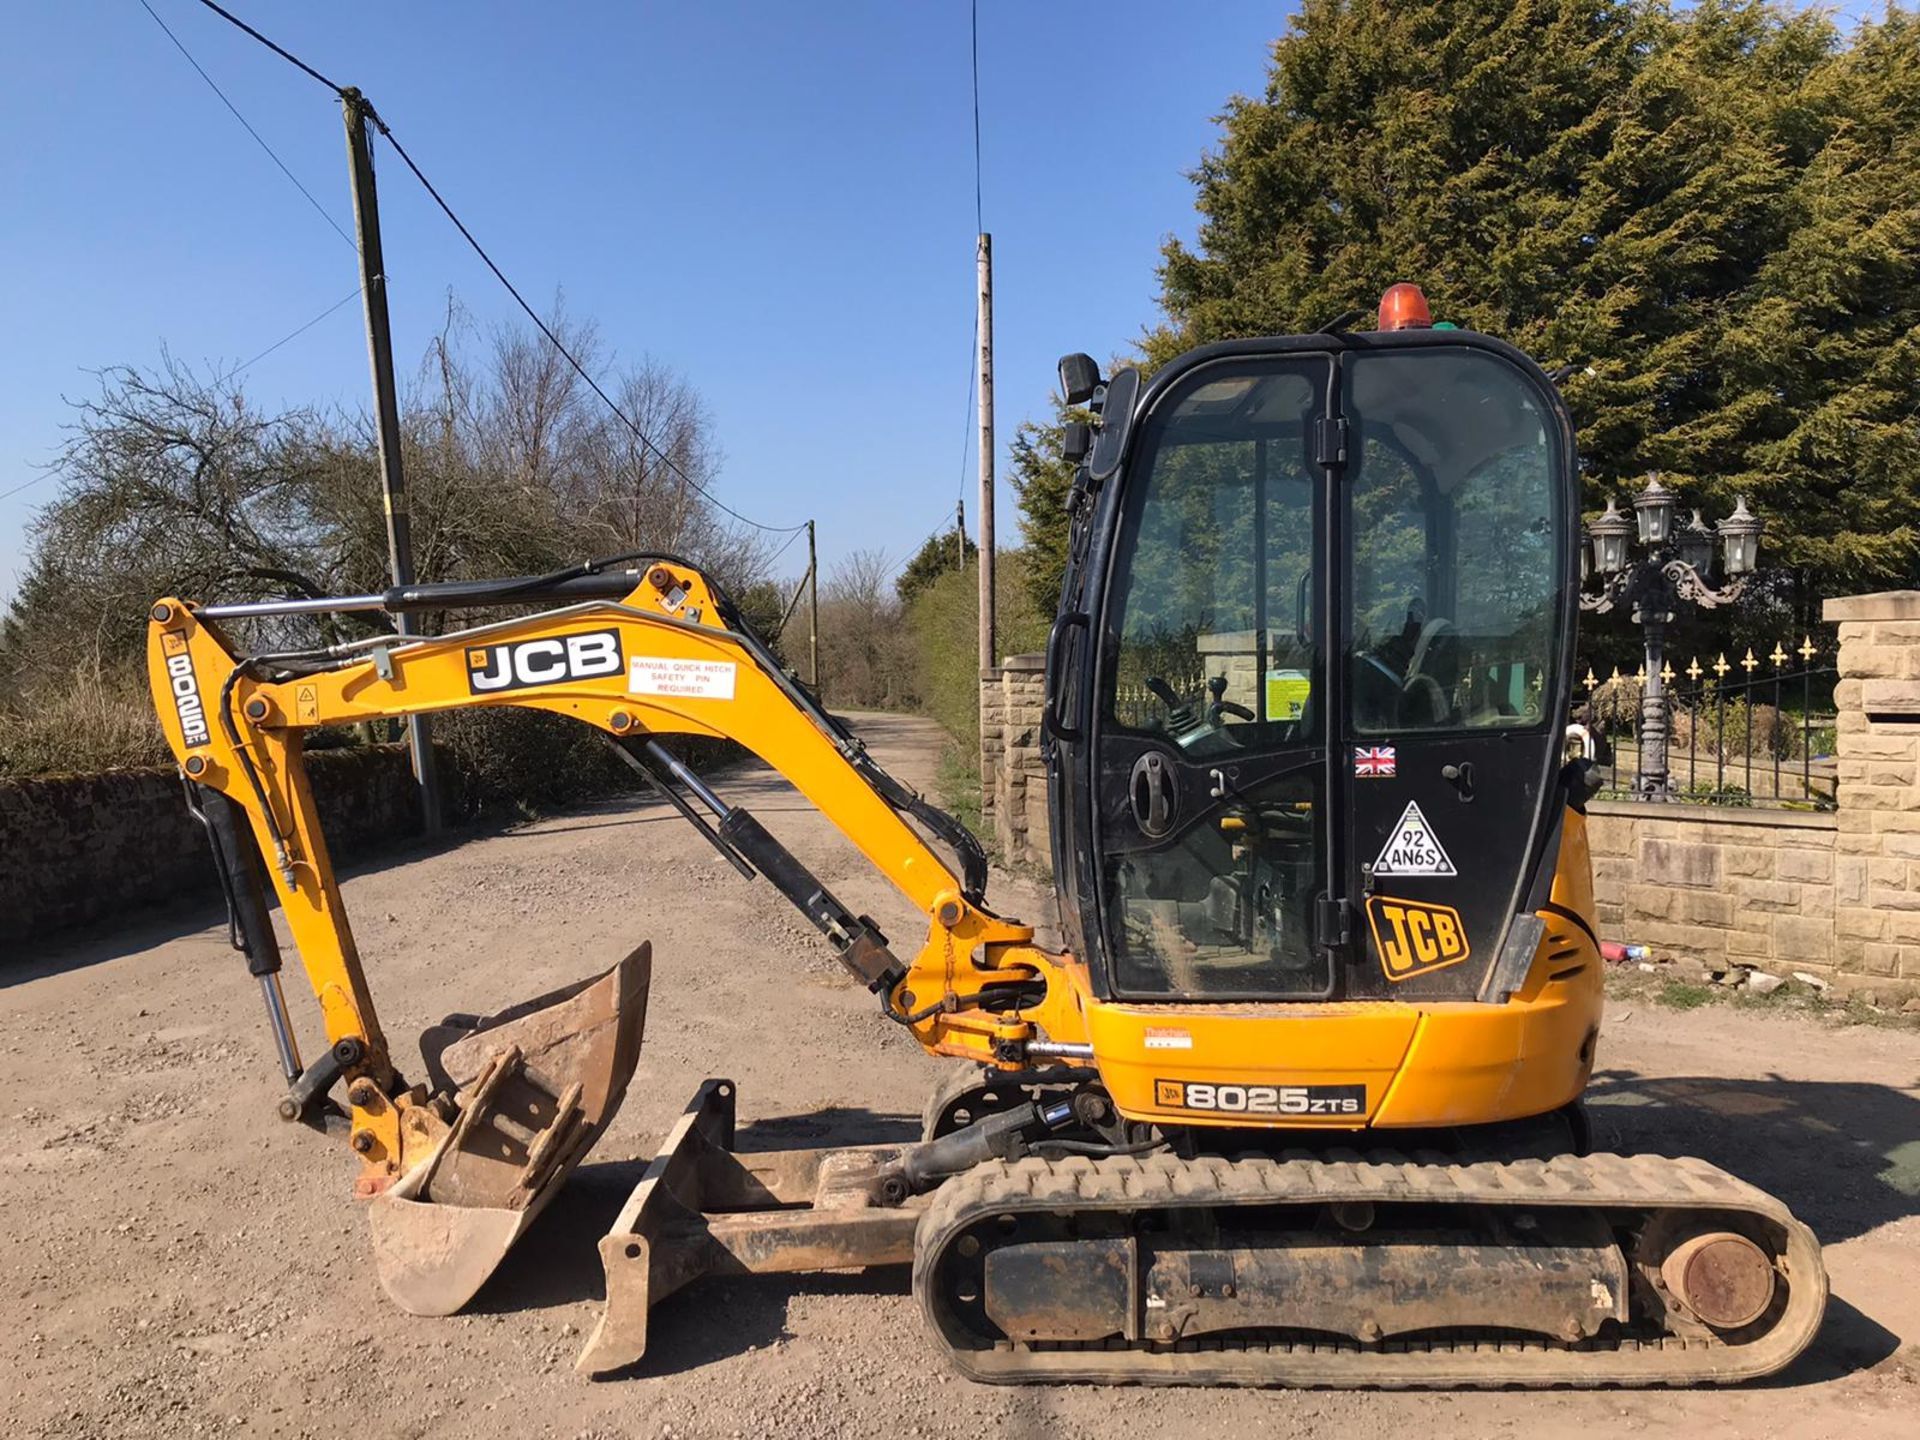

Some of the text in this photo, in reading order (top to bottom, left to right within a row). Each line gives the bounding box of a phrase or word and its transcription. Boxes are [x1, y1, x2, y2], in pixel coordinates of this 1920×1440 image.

[472, 633, 620, 689] JCB
[632, 661, 732, 673] MANUAL QUICK HITCH
[651, 673, 711, 683] SAFETY PIN
[168, 654, 206, 736] 8025
[657, 684, 704, 693] REQUIRED
[1403, 831, 1424, 848] 92
[1392, 849, 1436, 866] AN6S
[1383, 905, 1460, 971] JCB
